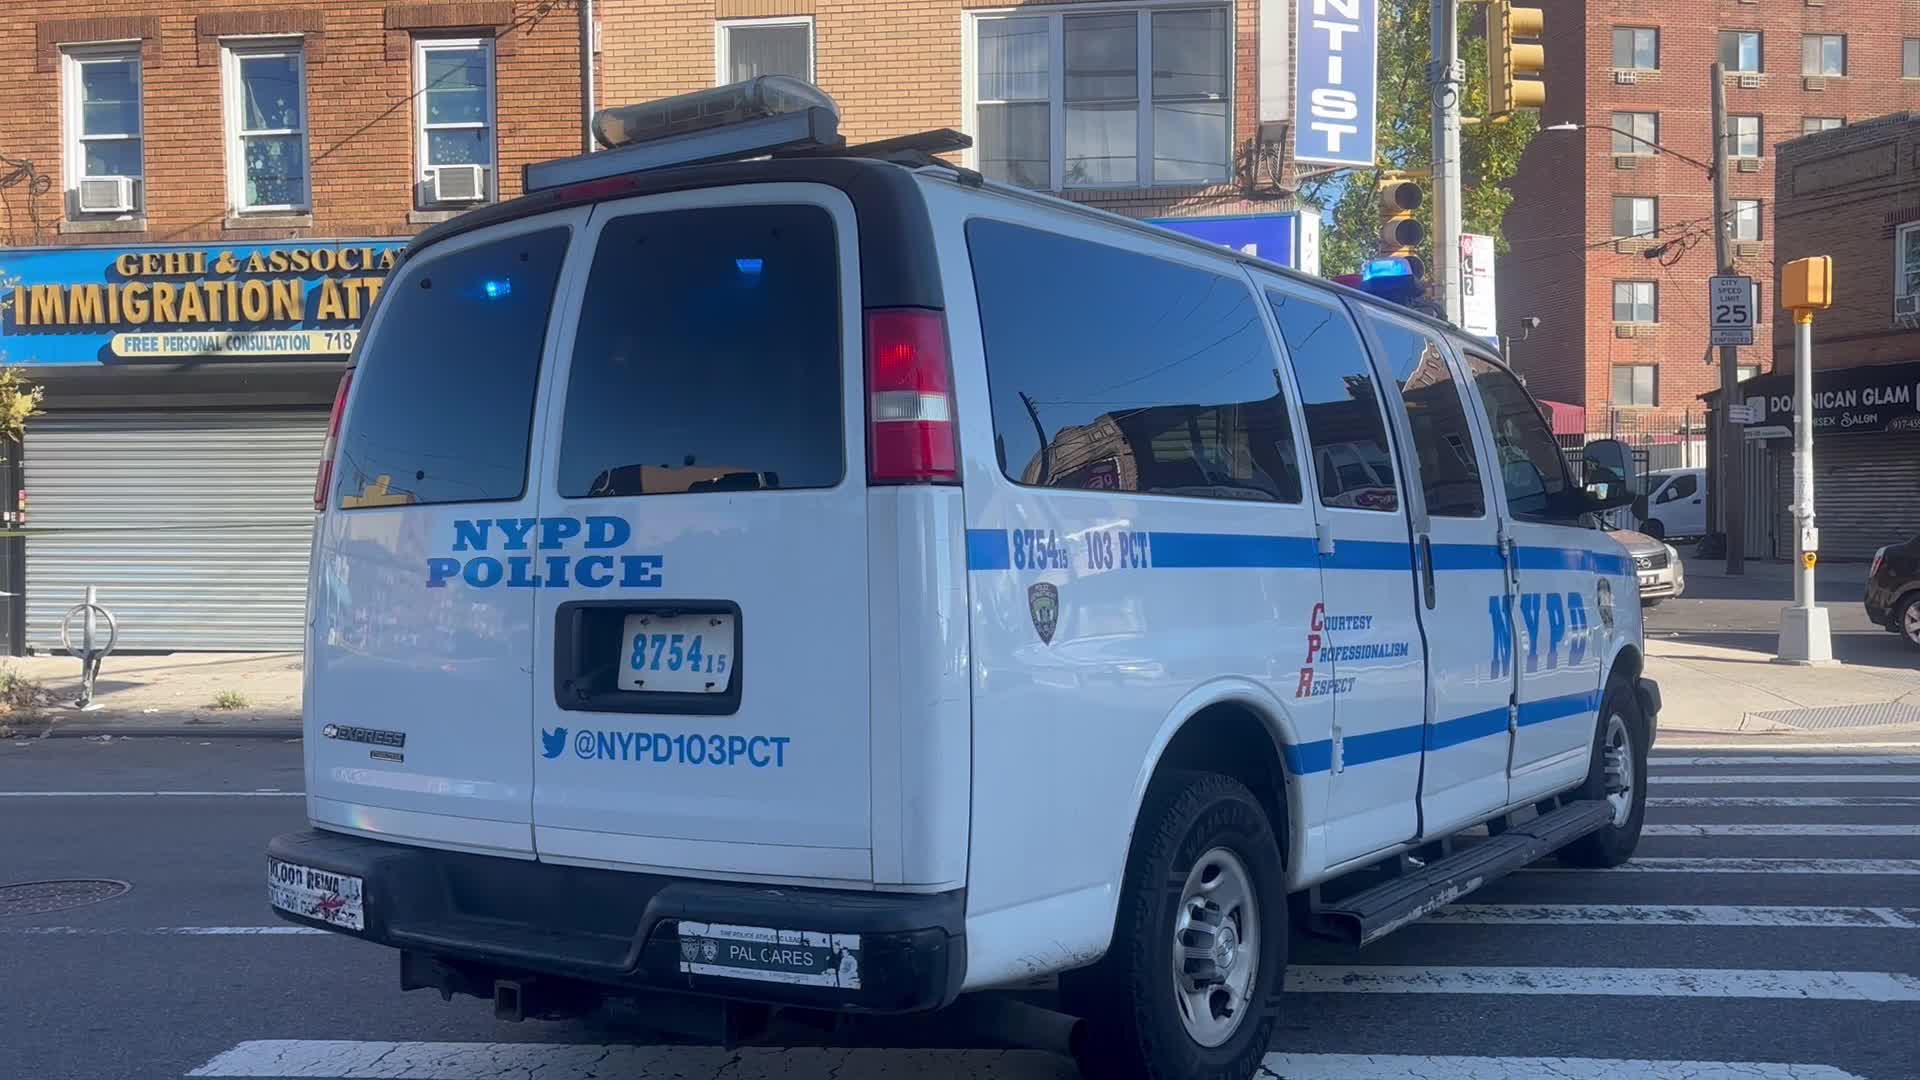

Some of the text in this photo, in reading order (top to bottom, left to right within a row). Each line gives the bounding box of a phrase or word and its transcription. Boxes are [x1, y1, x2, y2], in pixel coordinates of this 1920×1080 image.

[116, 247, 407, 276] GEHI & ASSOCIA
[15, 278, 304, 326] IMMIGRATION
[1718, 287, 1743, 295] SPEED
[1716, 304, 1748, 324] 25
[124, 332, 352, 353] FREE PERSONAL CONSULTATION 718
[1862, 384, 1910, 406] GLAM
[452, 516, 631, 551] NYPD
[1085, 531, 1114, 569] 103
[1118, 531, 1148, 568] PCT
[425, 555, 663, 588] POLICE
[1311, 602, 1373, 632] COURTESY
[1305, 634, 1409, 664] PROFESSIONALISM
[1488, 591, 1589, 681] NYPD
[1296, 667, 1357, 698] RESPECT
[338, 725, 404, 746] EXPRESS
[574, 730, 790, 769] @NYPD103PCT
[729, 945, 814, 967] PAL CARES
